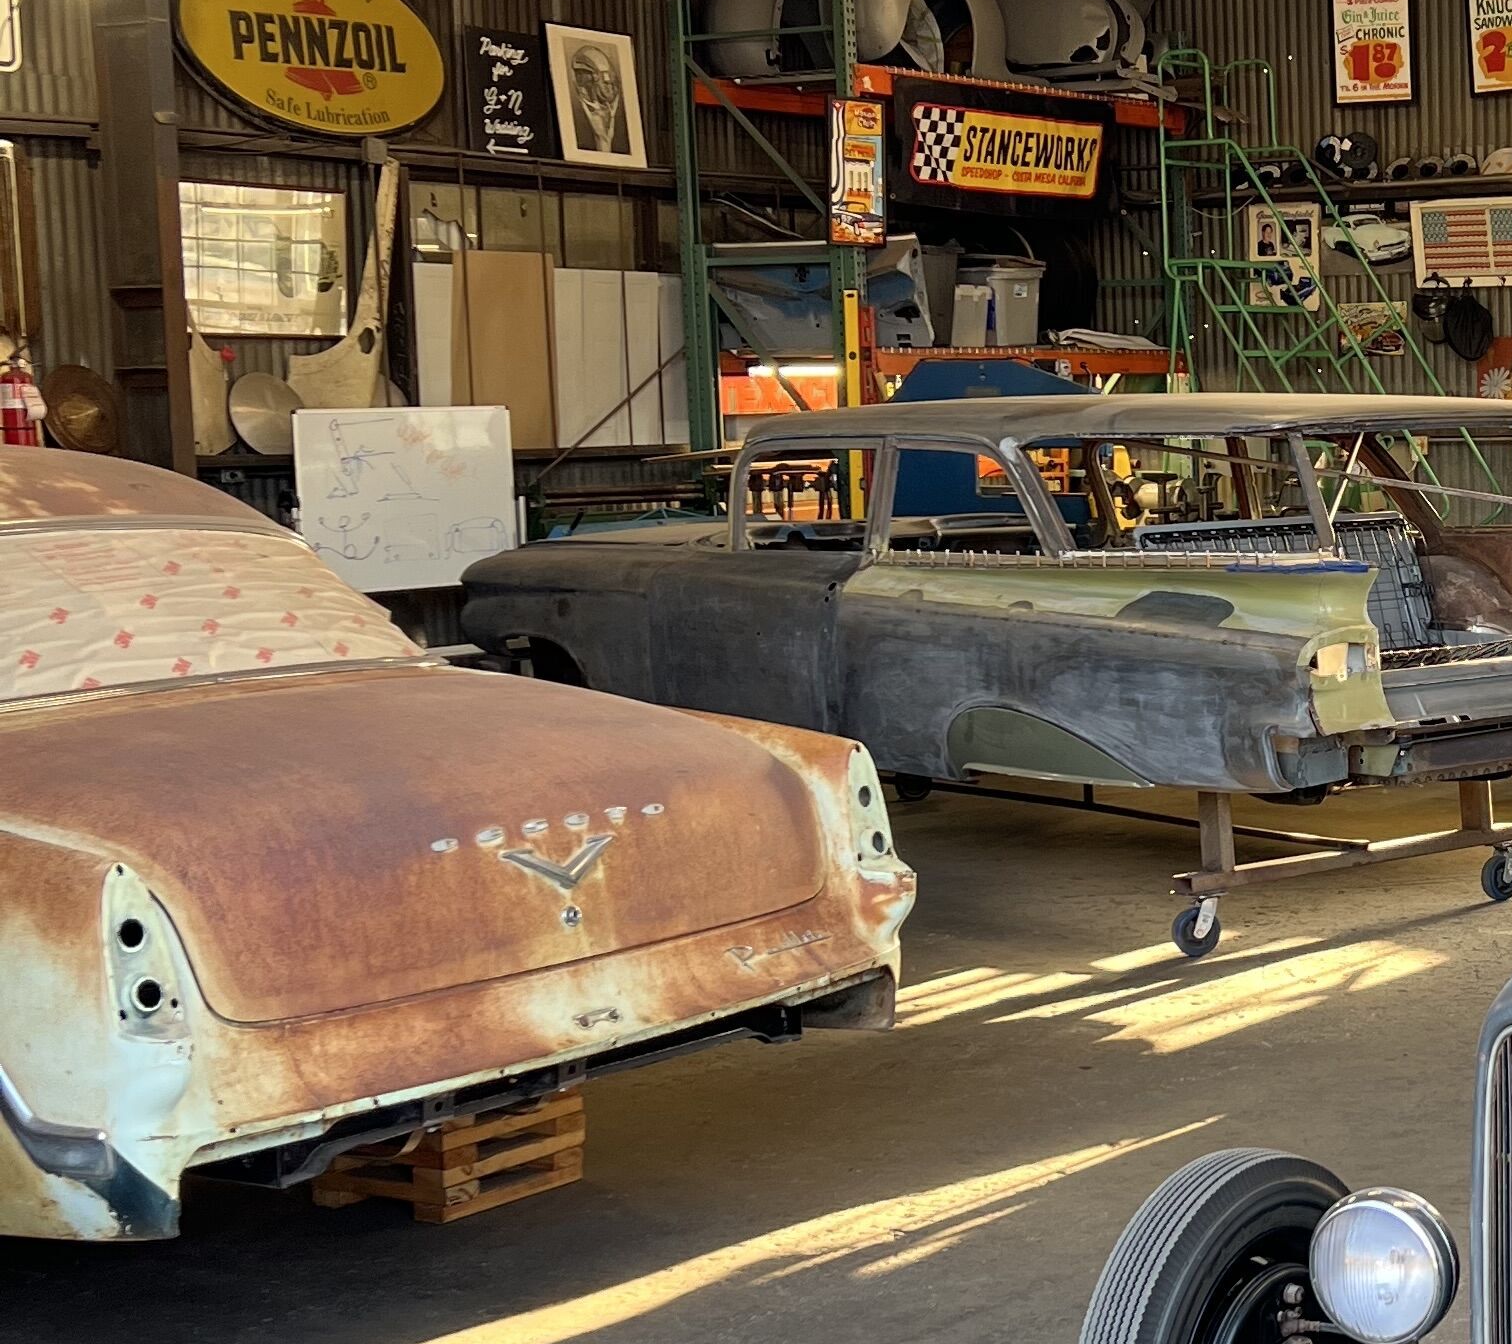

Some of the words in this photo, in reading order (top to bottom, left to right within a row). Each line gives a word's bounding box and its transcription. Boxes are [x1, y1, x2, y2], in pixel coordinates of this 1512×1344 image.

[1355, 25, 1405, 41] CHRONIC
[1368, 6, 1400, 23] Juice
[228, 9, 407, 74] PENNZOIL
[1482, 30, 1506, 73] 2
[266, 87, 302, 117] Safe
[306, 101, 391, 126] Lubrication
[963, 125, 1098, 174] STANCEWORKS
[961, 166, 1003, 181] SPEEDSHOP
[1012, 170, 1032, 183] COSTA
[1034, 171, 1056, 184] MESA
